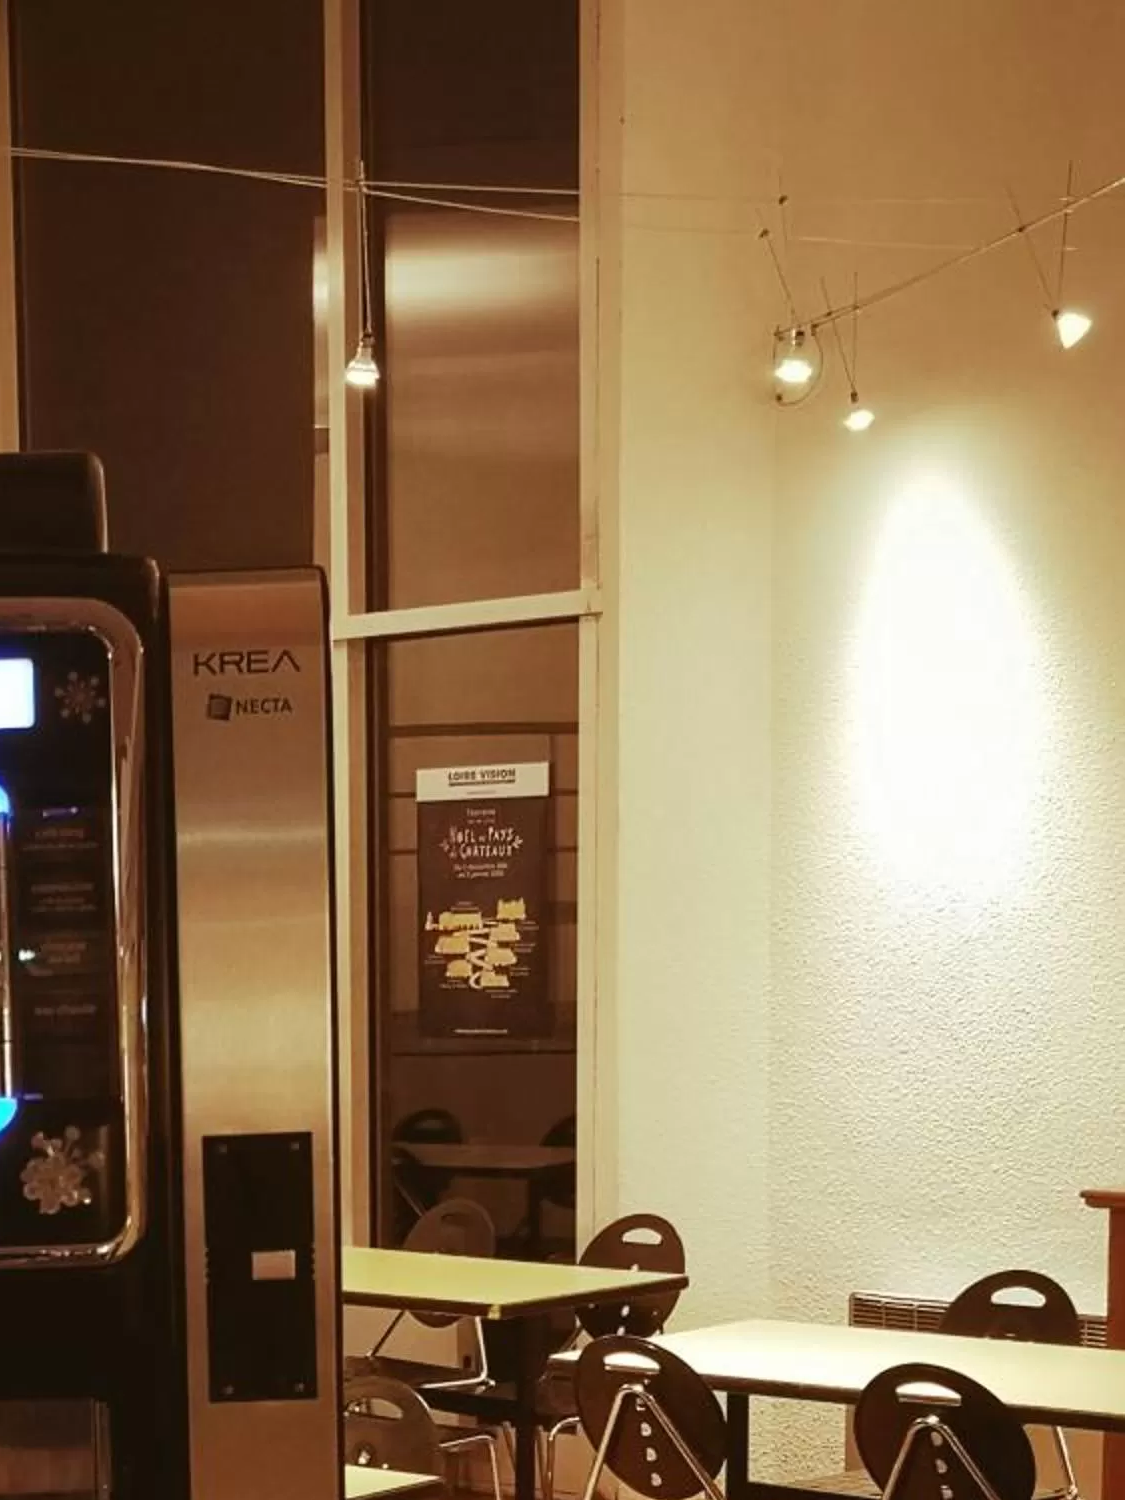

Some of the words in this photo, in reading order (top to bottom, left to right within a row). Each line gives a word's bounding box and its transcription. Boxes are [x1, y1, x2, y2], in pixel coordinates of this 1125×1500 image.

[192, 648, 302, 676] KREA
[235, 697, 293, 715] NECTA
[480, 768, 516, 779] VISION
